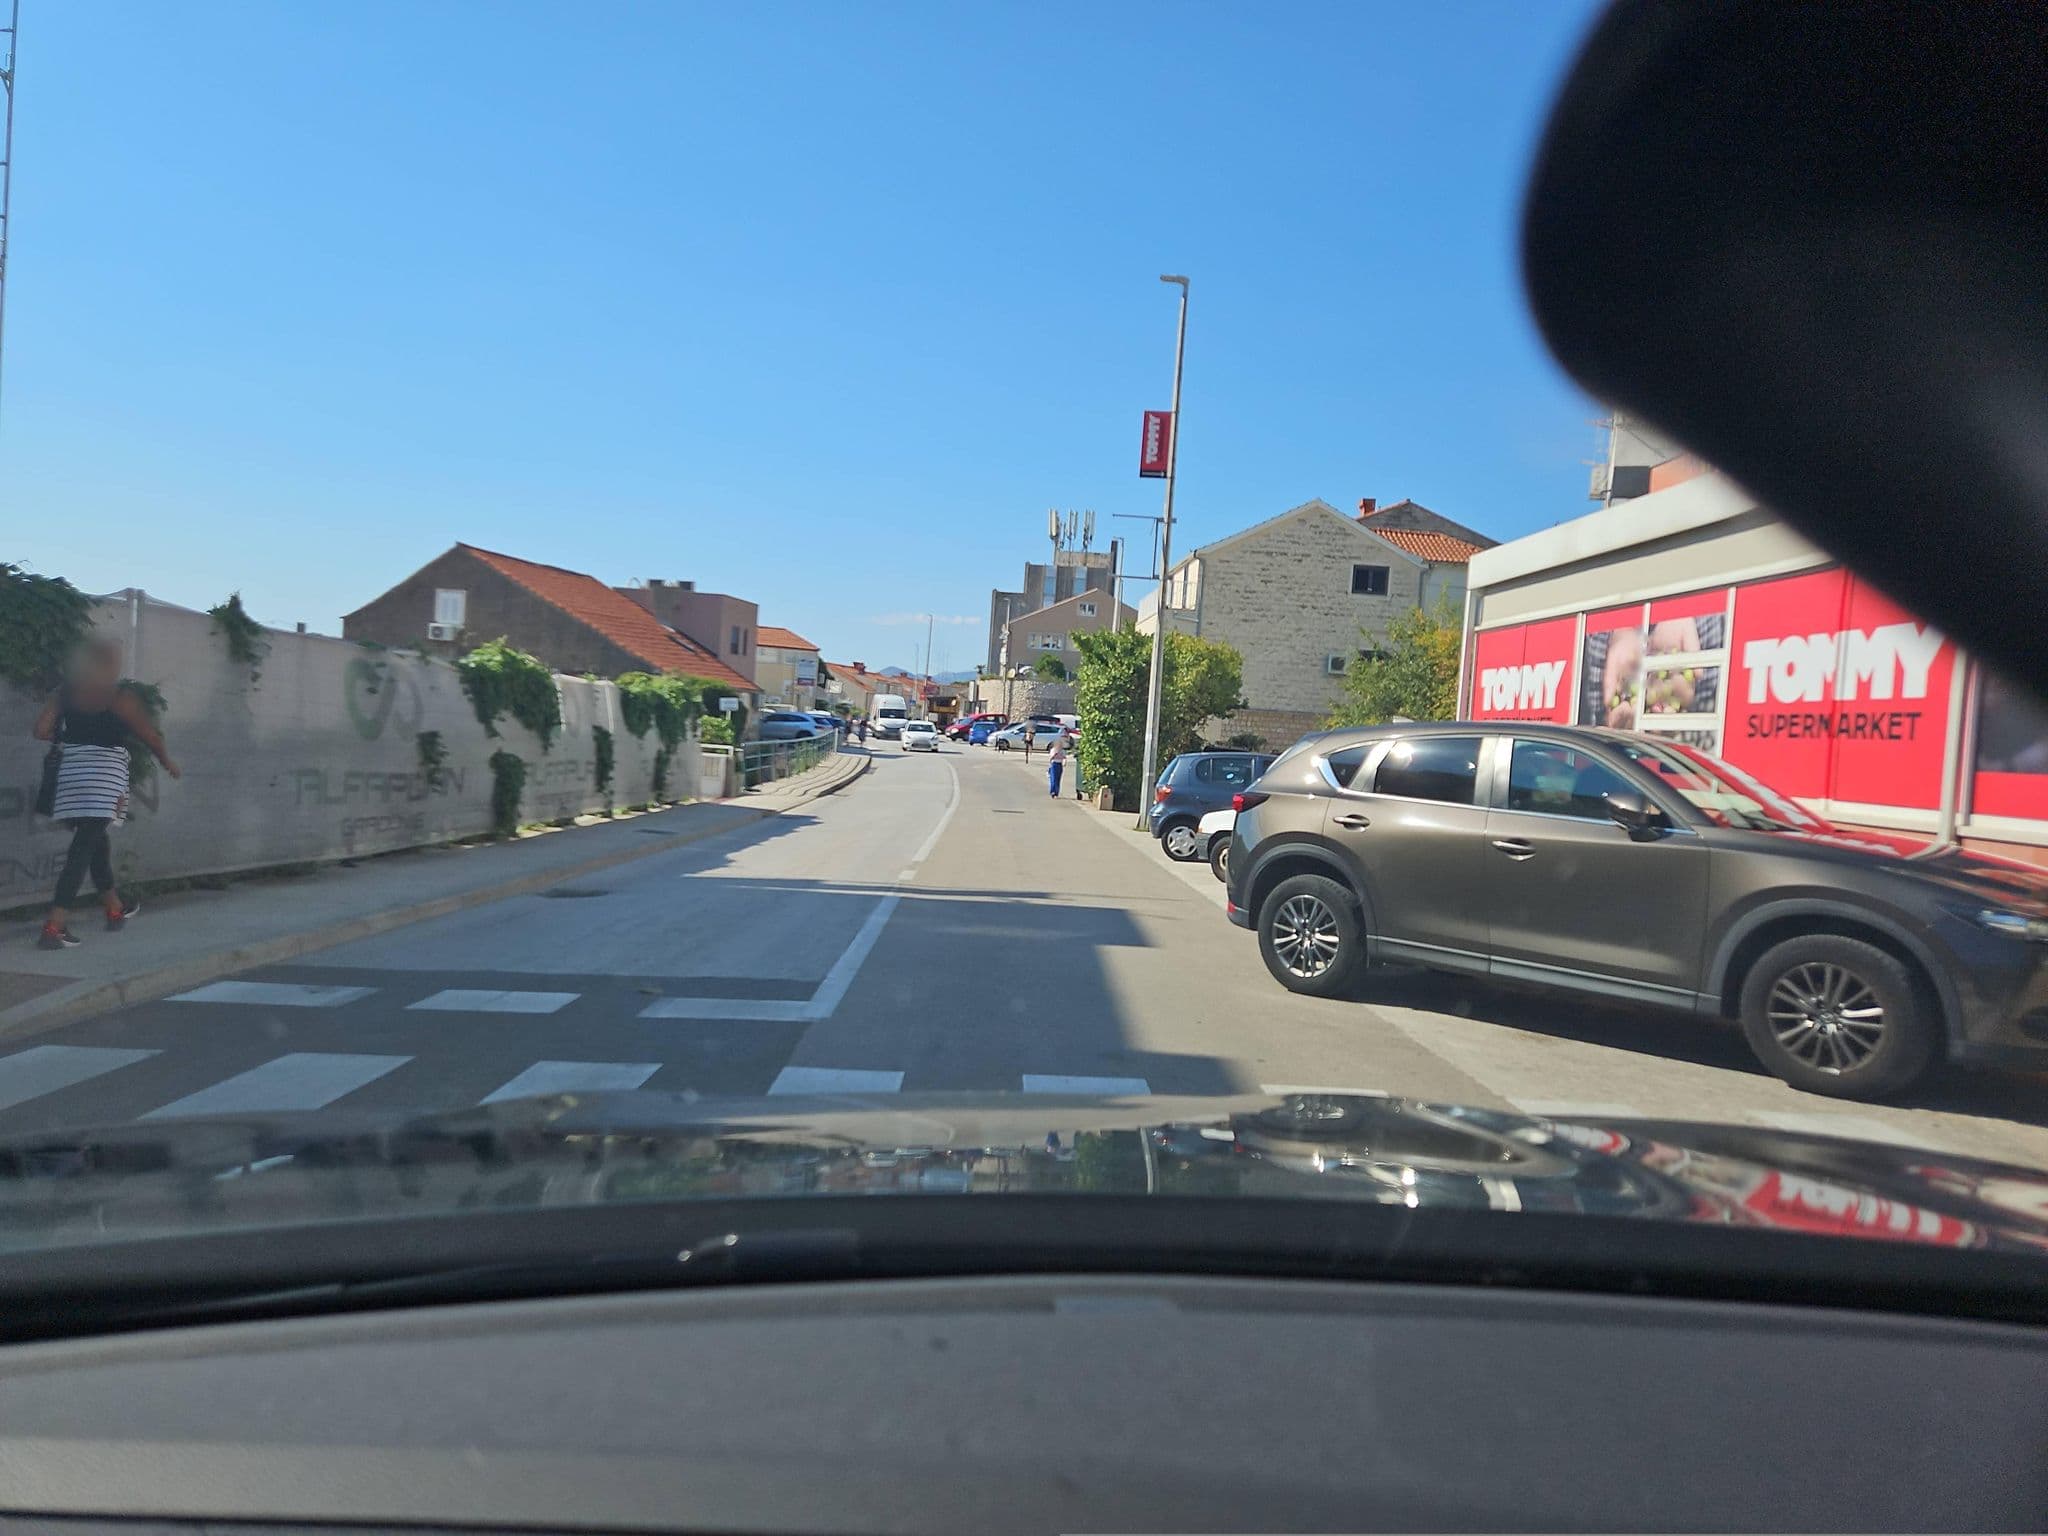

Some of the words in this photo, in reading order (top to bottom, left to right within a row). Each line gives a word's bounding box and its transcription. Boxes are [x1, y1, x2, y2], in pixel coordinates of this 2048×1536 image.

[1481, 660, 1568, 712] TOMMY
[1742, 622, 1946, 704] TOMMY
[1747, 711, 1922, 741] SUPERMARKET
